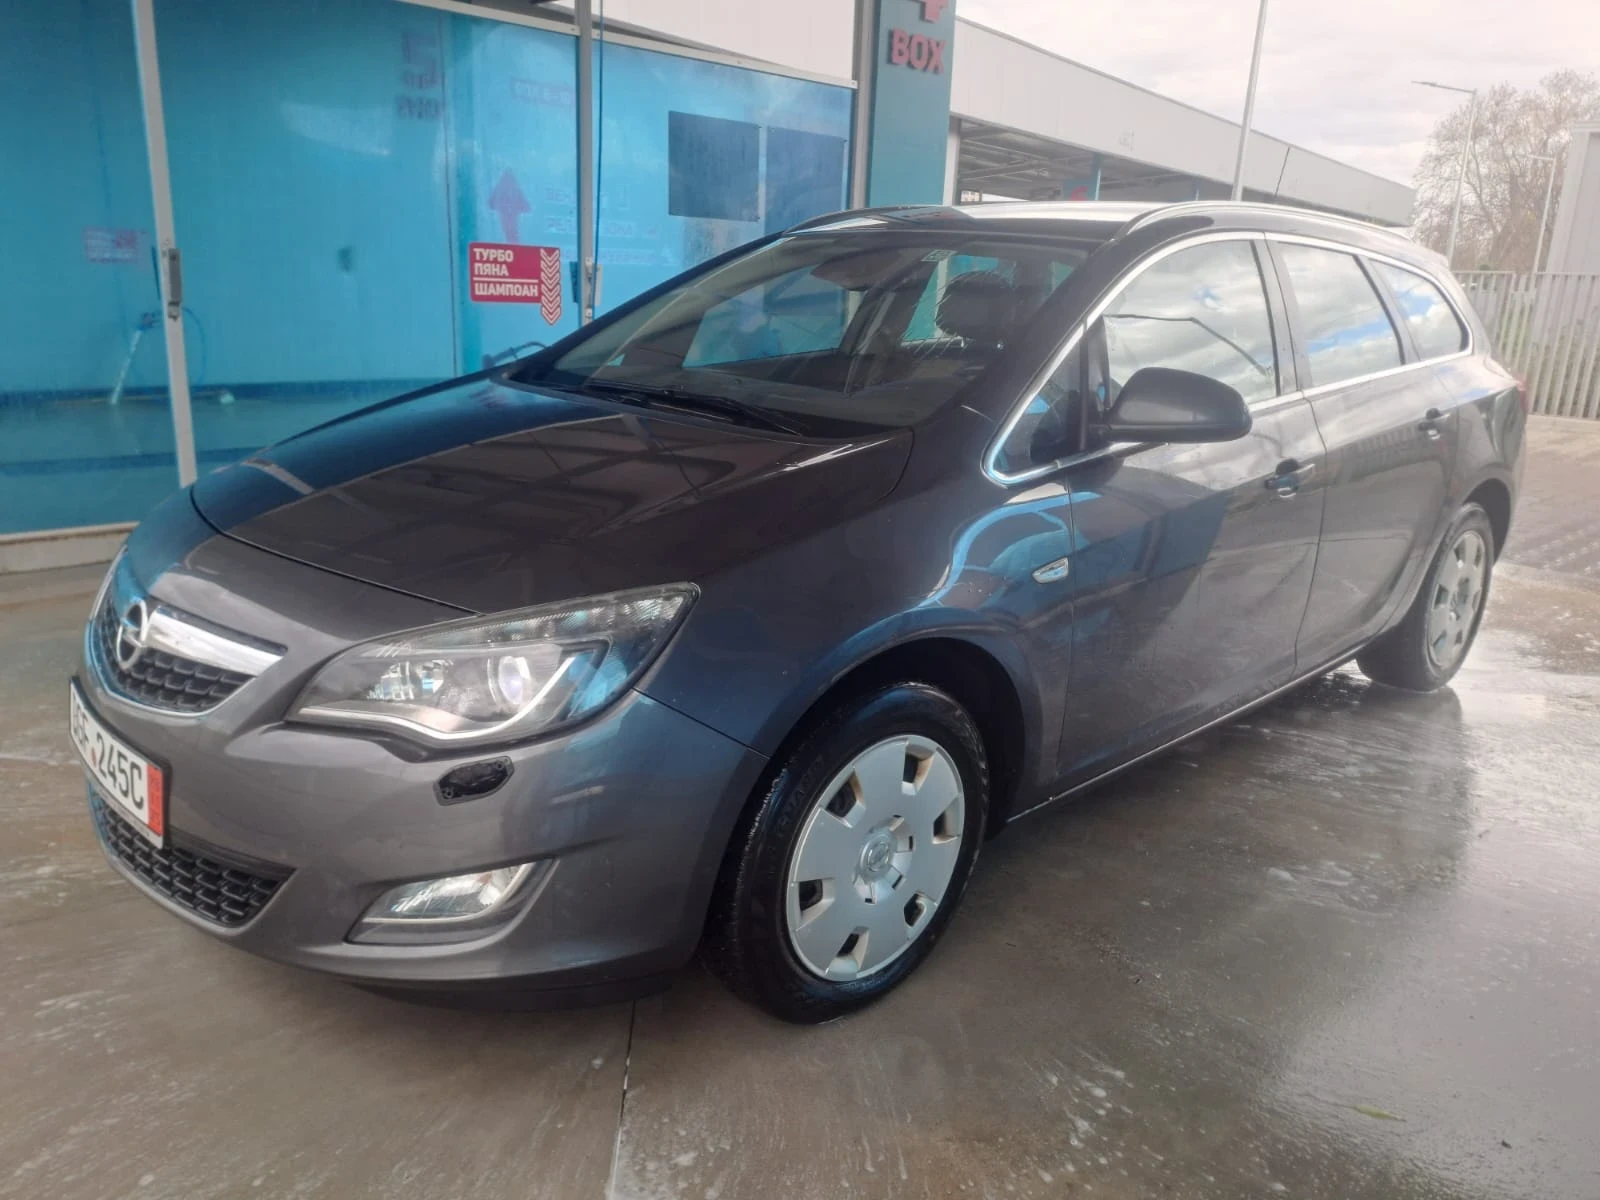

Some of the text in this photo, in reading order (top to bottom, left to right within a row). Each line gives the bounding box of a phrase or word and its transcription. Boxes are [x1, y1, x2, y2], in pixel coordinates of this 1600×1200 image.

[891, 27, 947, 74] BOX
[473, 247, 514, 262] ТУРБО
[474, 262, 509, 276] ПЯНА
[474, 282, 539, 297] ШАМПОАН
[97, 732, 144, 810] 245C
